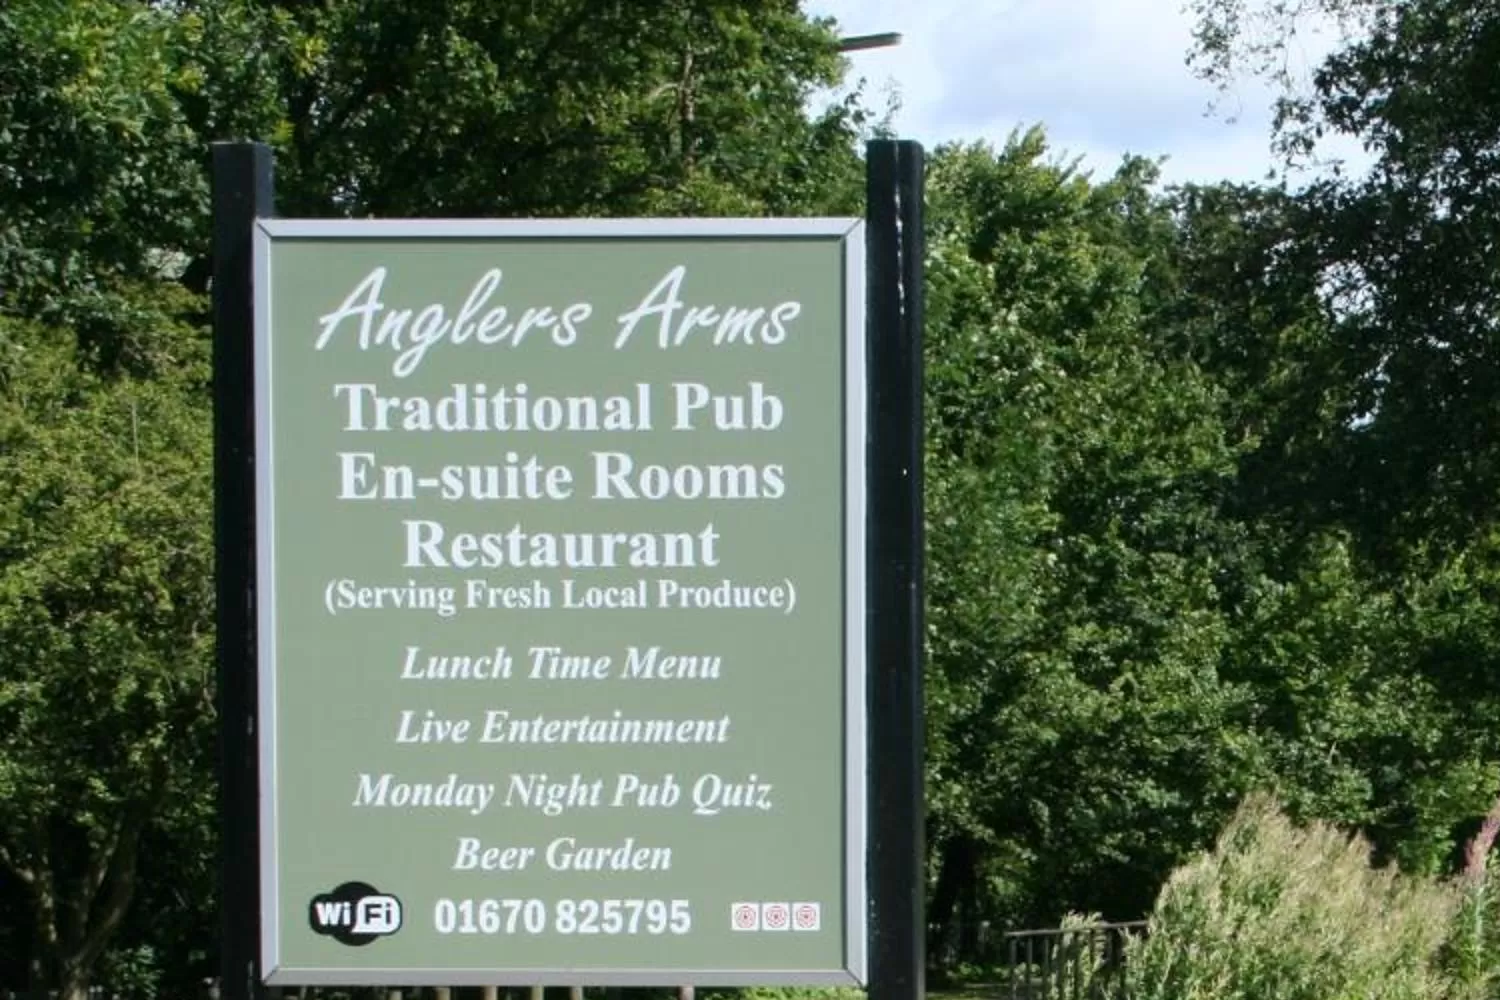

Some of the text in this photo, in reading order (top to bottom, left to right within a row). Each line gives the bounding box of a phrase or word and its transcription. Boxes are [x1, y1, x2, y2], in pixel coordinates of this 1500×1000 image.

[315, 265, 801, 378] Anglers Arms
[334, 381, 783, 432] Traditional Pub
[338, 451, 785, 501] En-suite Rooms
[403, 520, 720, 568] Restaurant
[325, 579, 796, 617] (Serving Fresh Local Produce)
[400, 646, 721, 679] Lunch Time Menu
[395, 709, 730, 743] Live Entertainment
[352, 773, 772, 816] Monday Night Pub Quiz
[452, 837, 672, 871] Beer Garden
[434, 898, 692, 935] 01670 825795
